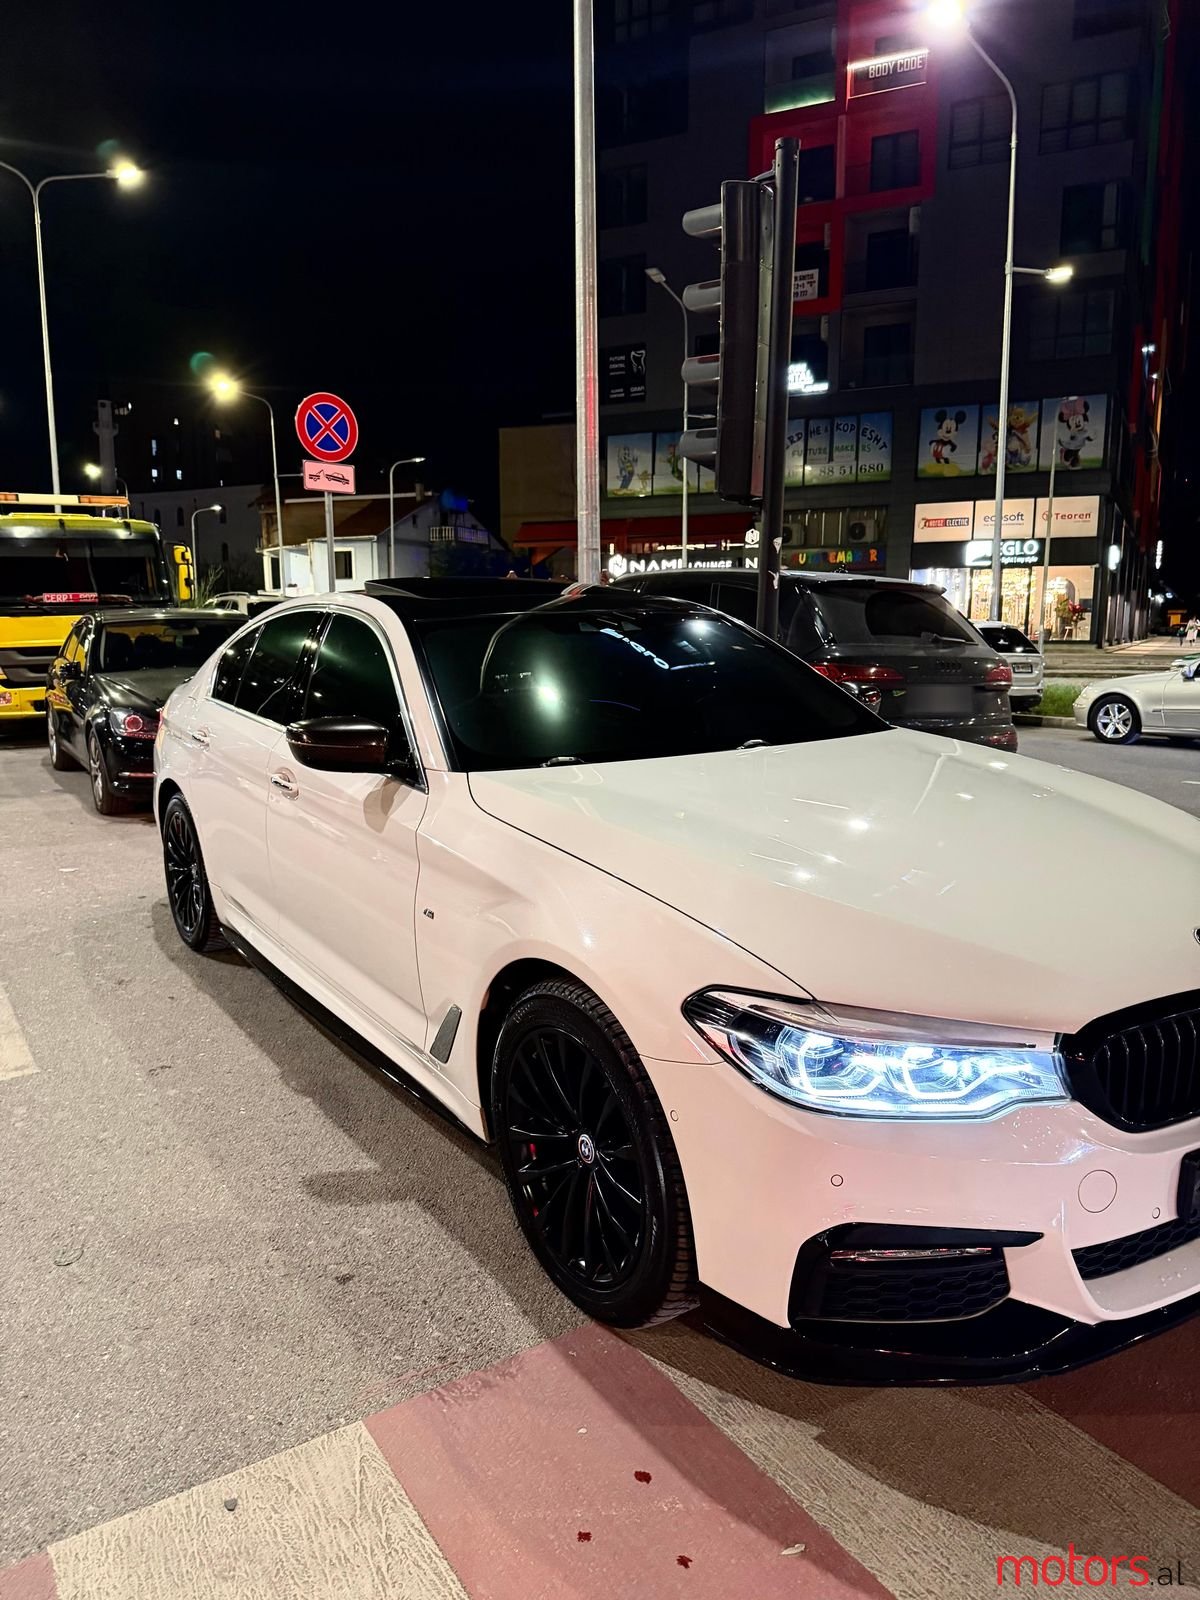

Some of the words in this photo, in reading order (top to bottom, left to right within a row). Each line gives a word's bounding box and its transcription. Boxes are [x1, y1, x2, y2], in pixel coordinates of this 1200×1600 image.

[869, 62, 895, 78] BODY
[897, 56, 923, 73] CODE
[859, 463, 884, 474] 680
[983, 512, 1025, 525] ecsoft
[1055, 512, 1091, 520] Teoren
[629, 558, 683, 574] NAMI
